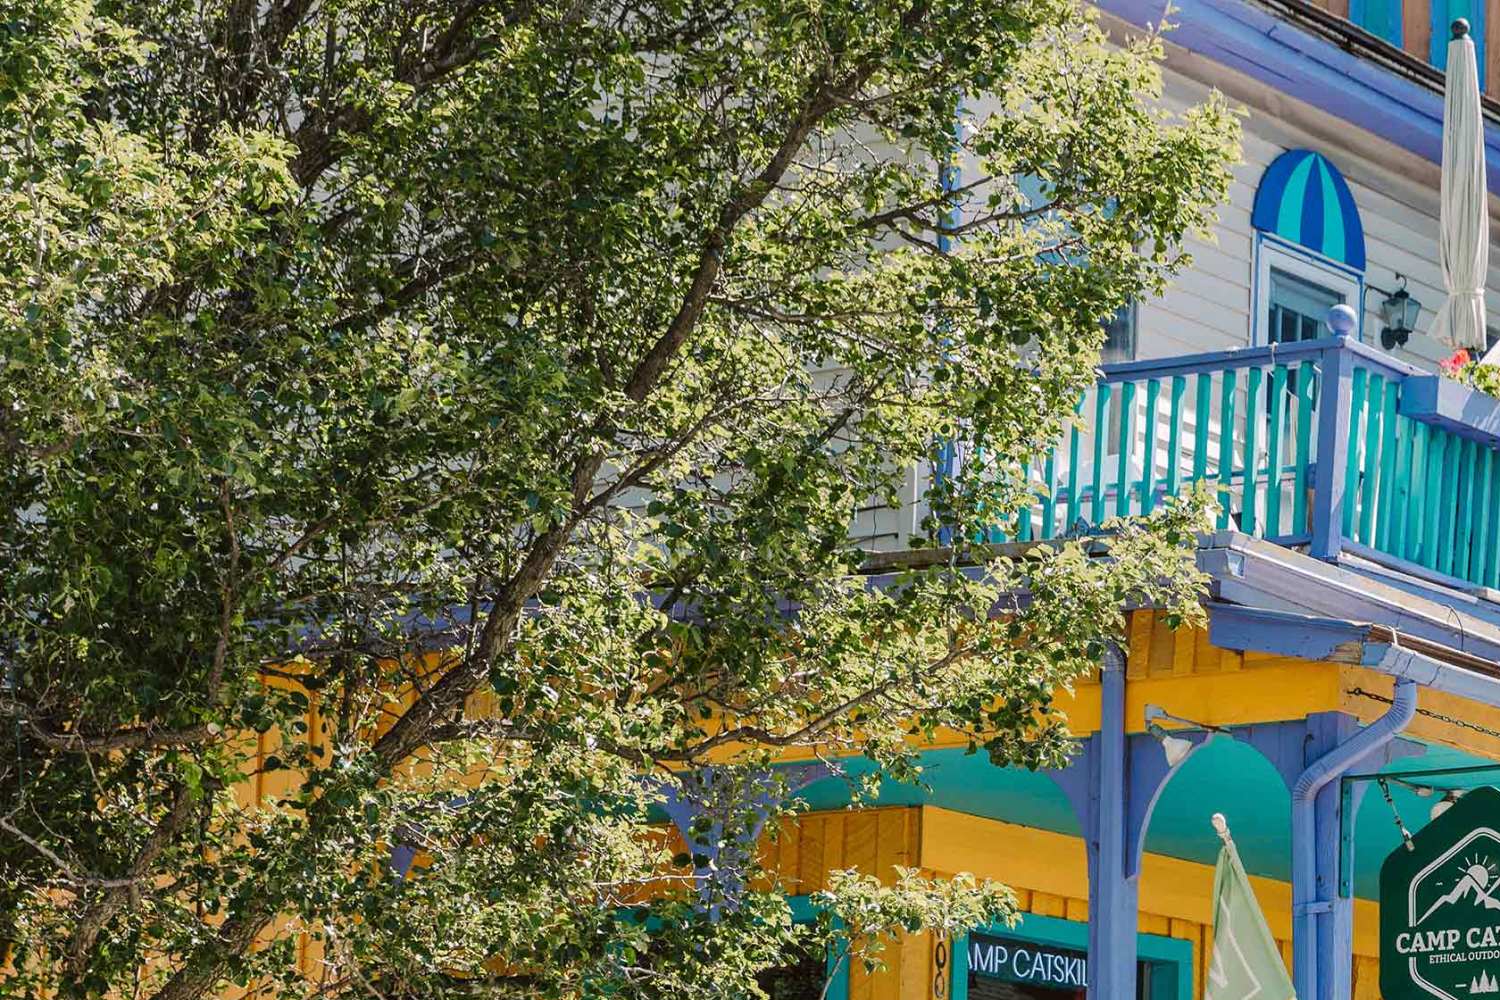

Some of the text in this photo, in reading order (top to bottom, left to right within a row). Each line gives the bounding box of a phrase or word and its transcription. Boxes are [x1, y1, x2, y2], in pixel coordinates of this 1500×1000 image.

[1396, 929, 1460, 954] CAMP
[968, 943, 1088, 987] MP CATSKIL
[1429, 952, 1467, 964] ETHICAL
